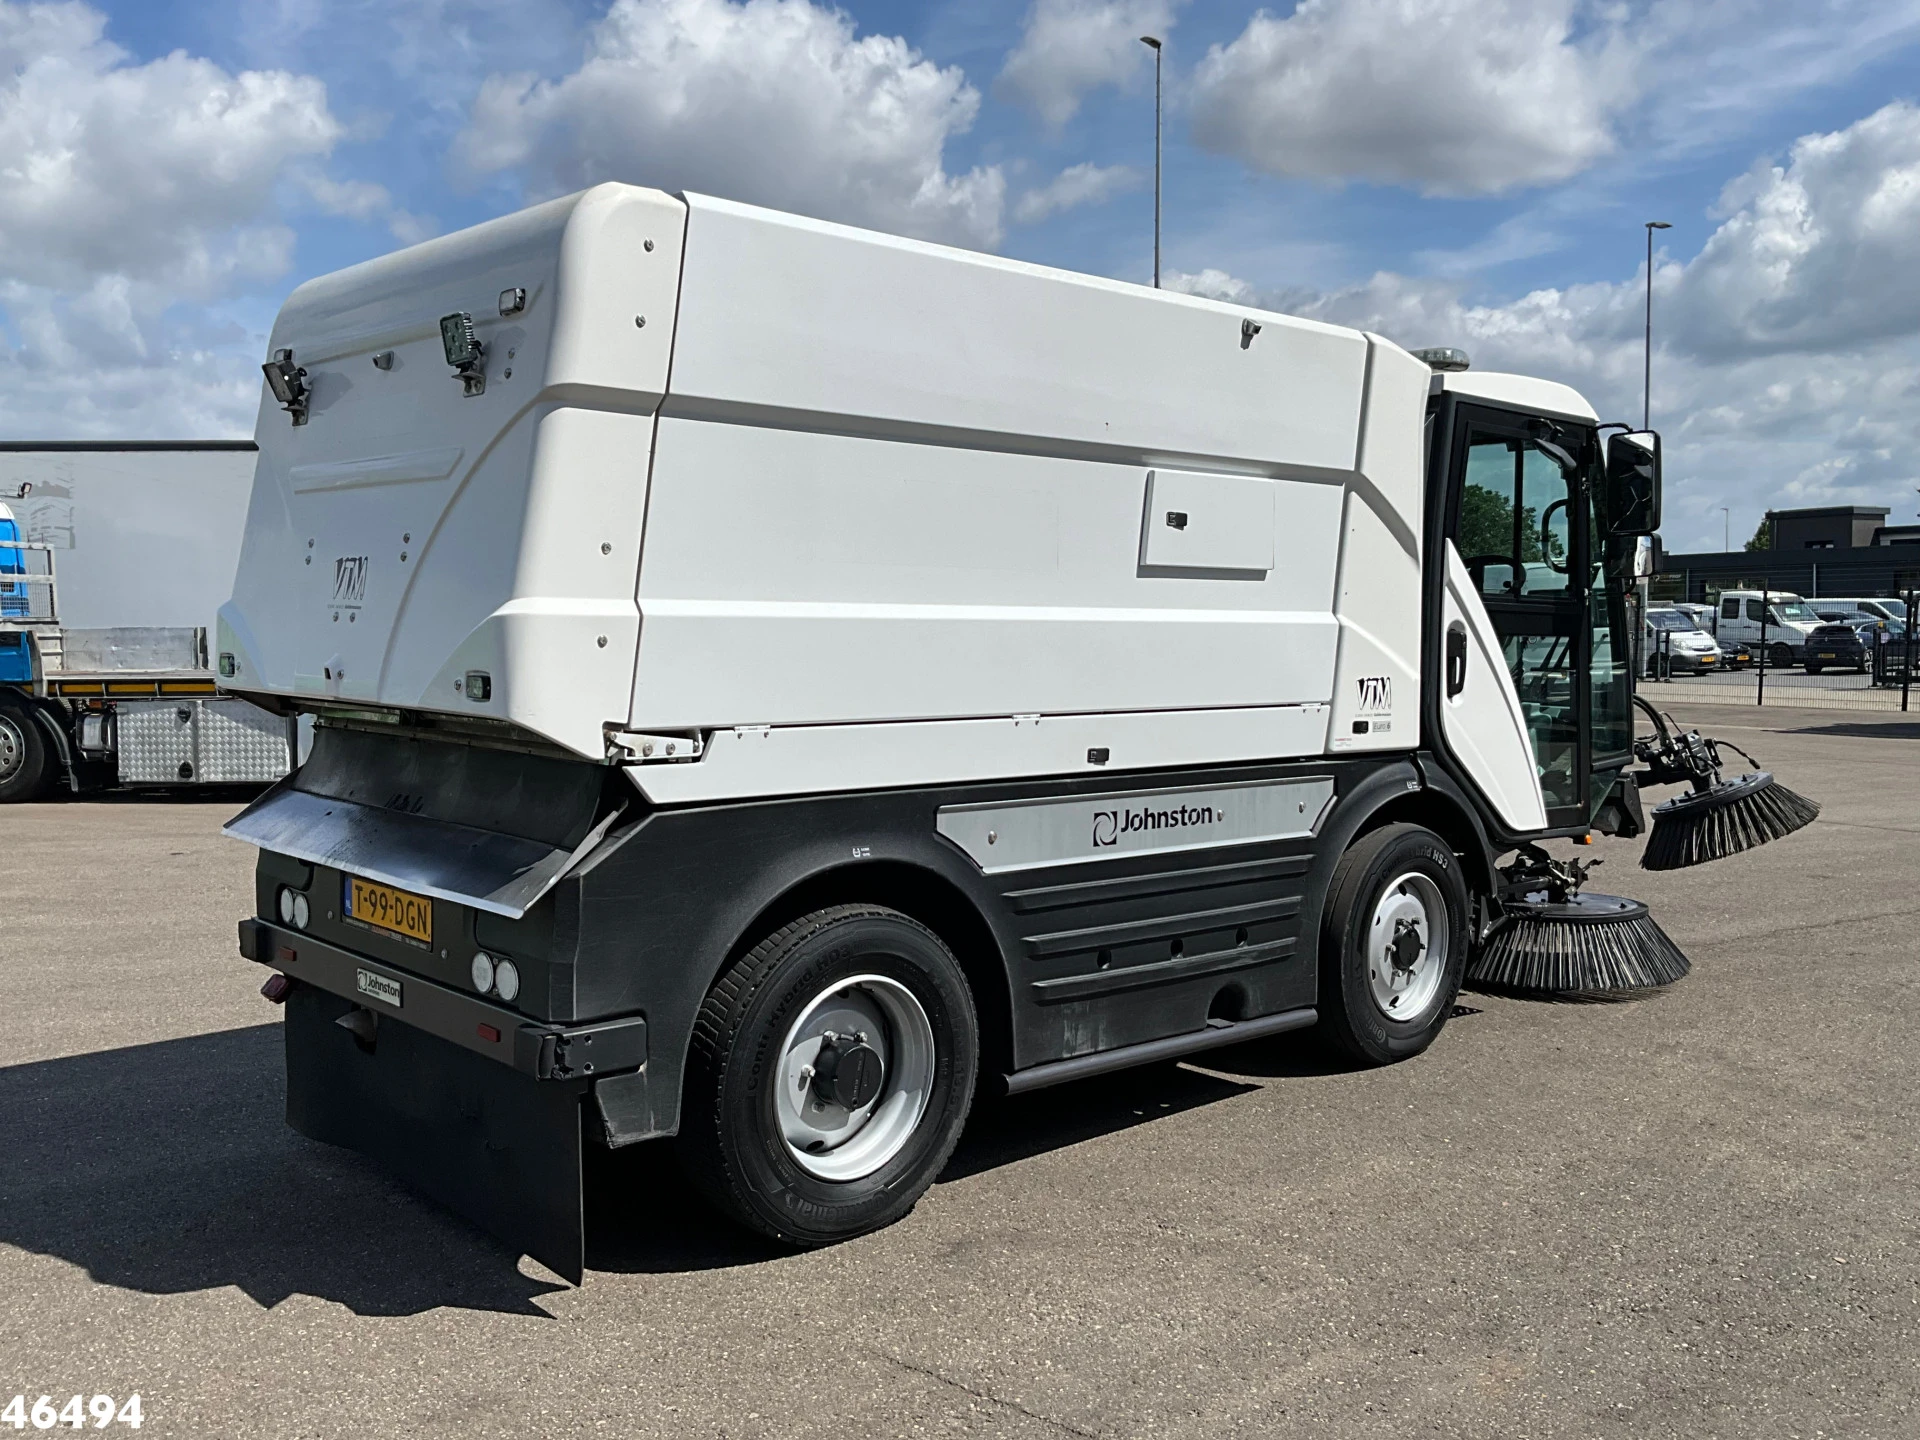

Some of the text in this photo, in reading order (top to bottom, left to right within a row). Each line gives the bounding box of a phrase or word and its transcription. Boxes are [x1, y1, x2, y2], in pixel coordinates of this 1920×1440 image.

[333, 556, 369, 600] VTM
[1356, 677, 1392, 710] VTM
[1120, 804, 1213, 833] Johnston
[1432, 849, 1448, 870] HS3
[355, 884, 428, 935] T-99-DGN
[367, 975, 400, 998] Johnston
